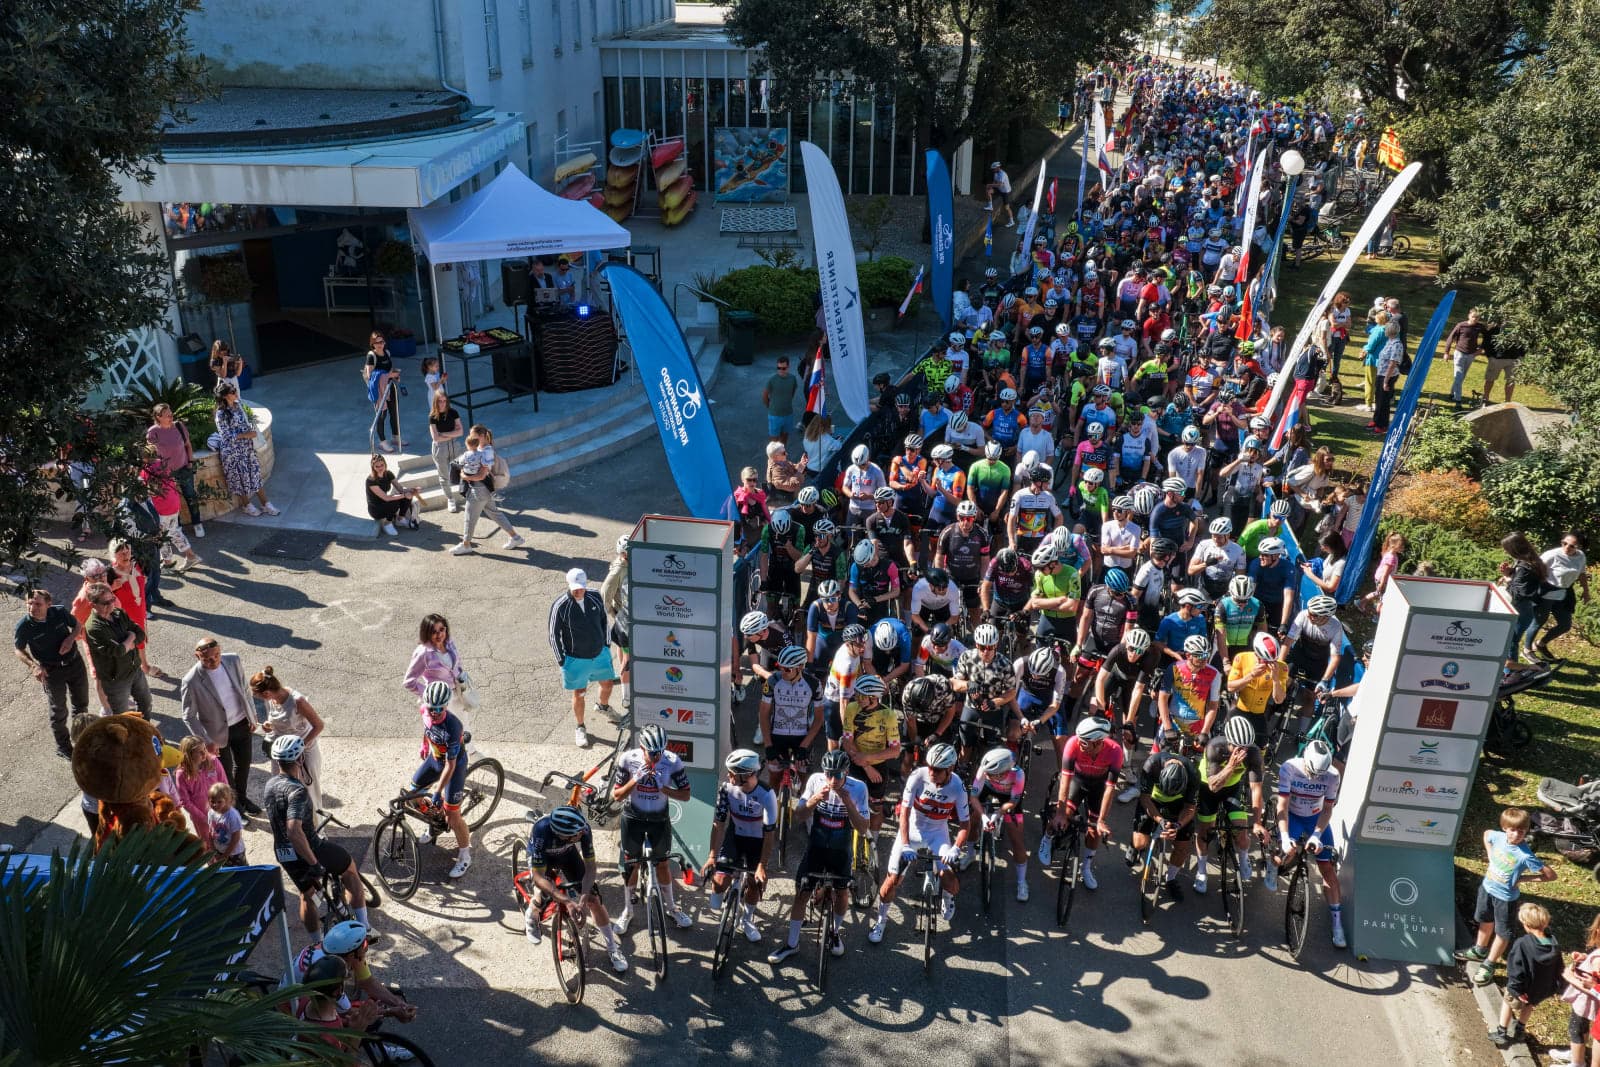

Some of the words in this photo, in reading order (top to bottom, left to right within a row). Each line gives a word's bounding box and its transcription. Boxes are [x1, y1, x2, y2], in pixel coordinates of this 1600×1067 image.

[671, 605, 692, 613] Fondo
[663, 647, 685, 658] KRK
[1384, 912, 1424, 923] HOTEL
[1363, 920, 1396, 930] PARK
[1403, 923, 1445, 935] PUNAT
